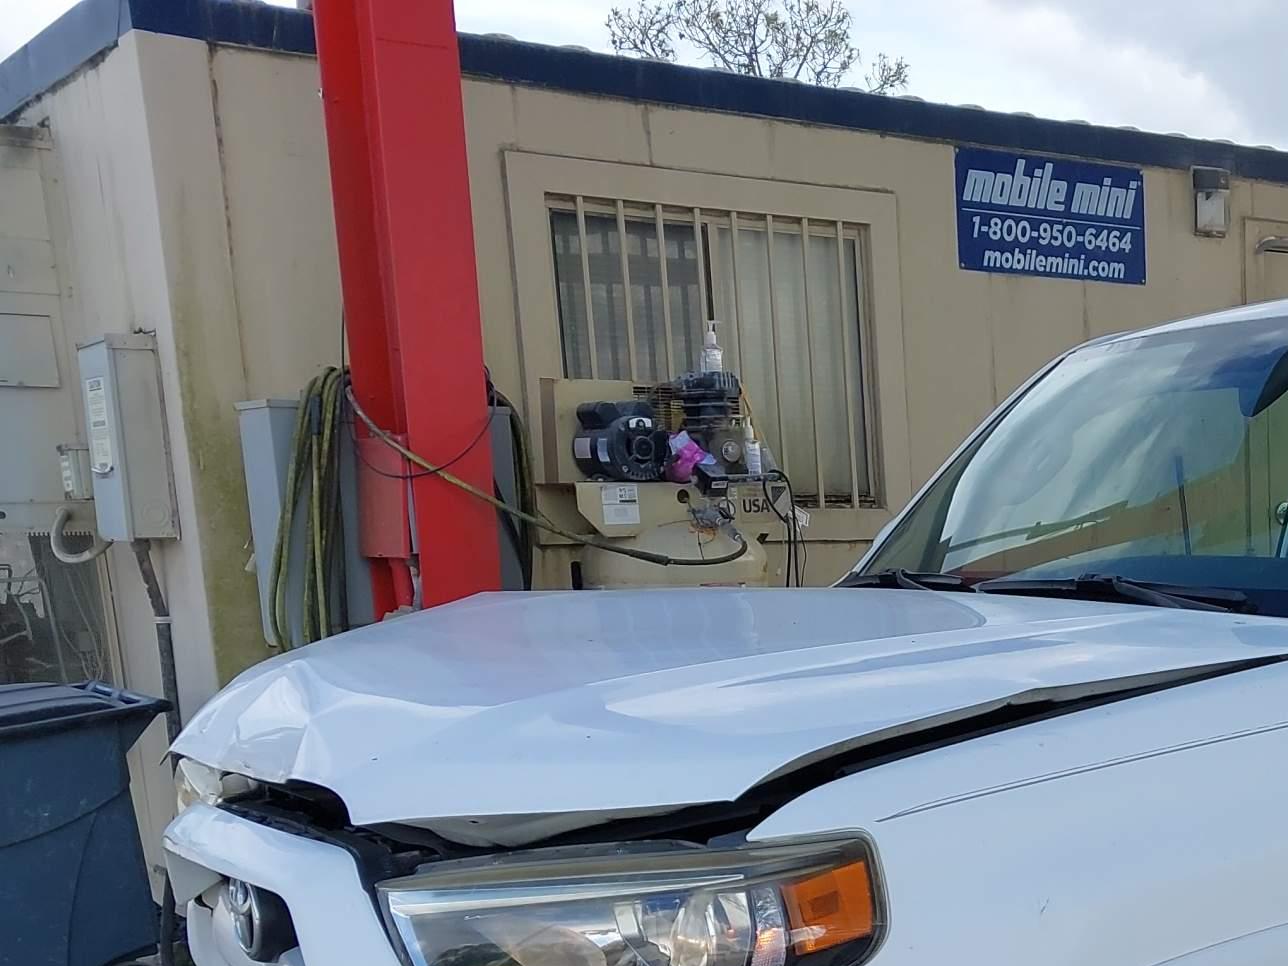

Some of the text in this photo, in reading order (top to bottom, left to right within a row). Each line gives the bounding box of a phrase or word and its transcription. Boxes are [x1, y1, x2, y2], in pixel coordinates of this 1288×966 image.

[962, 158, 1137, 219] mobile mini
[972, 215, 1132, 253] 1-800-950-6464
[983, 248, 1125, 279] mobilemini.com
[742, 498, 771, 513] USA
